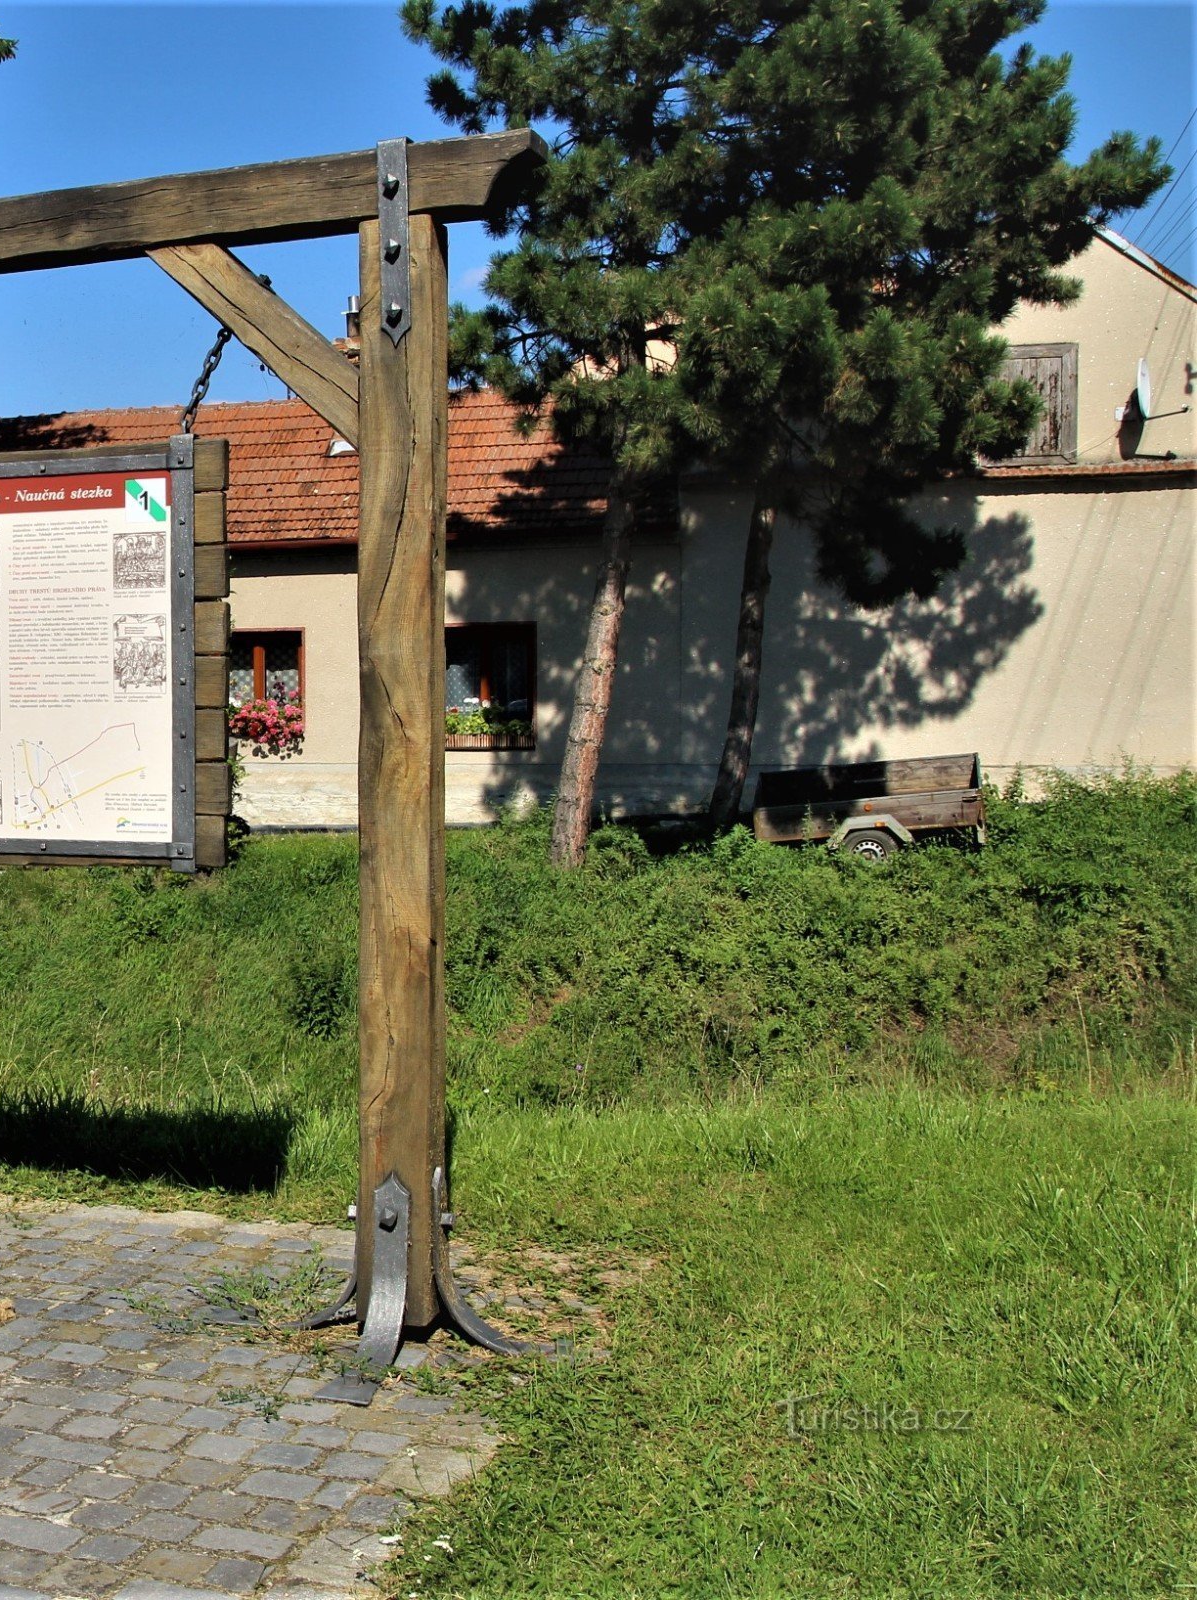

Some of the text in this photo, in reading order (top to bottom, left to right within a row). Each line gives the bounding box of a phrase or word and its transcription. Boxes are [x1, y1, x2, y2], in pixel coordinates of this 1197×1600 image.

[14, 488, 64, 503] Naučná
[70, 486, 113, 499] stezka
[139, 491, 149, 511] 1
